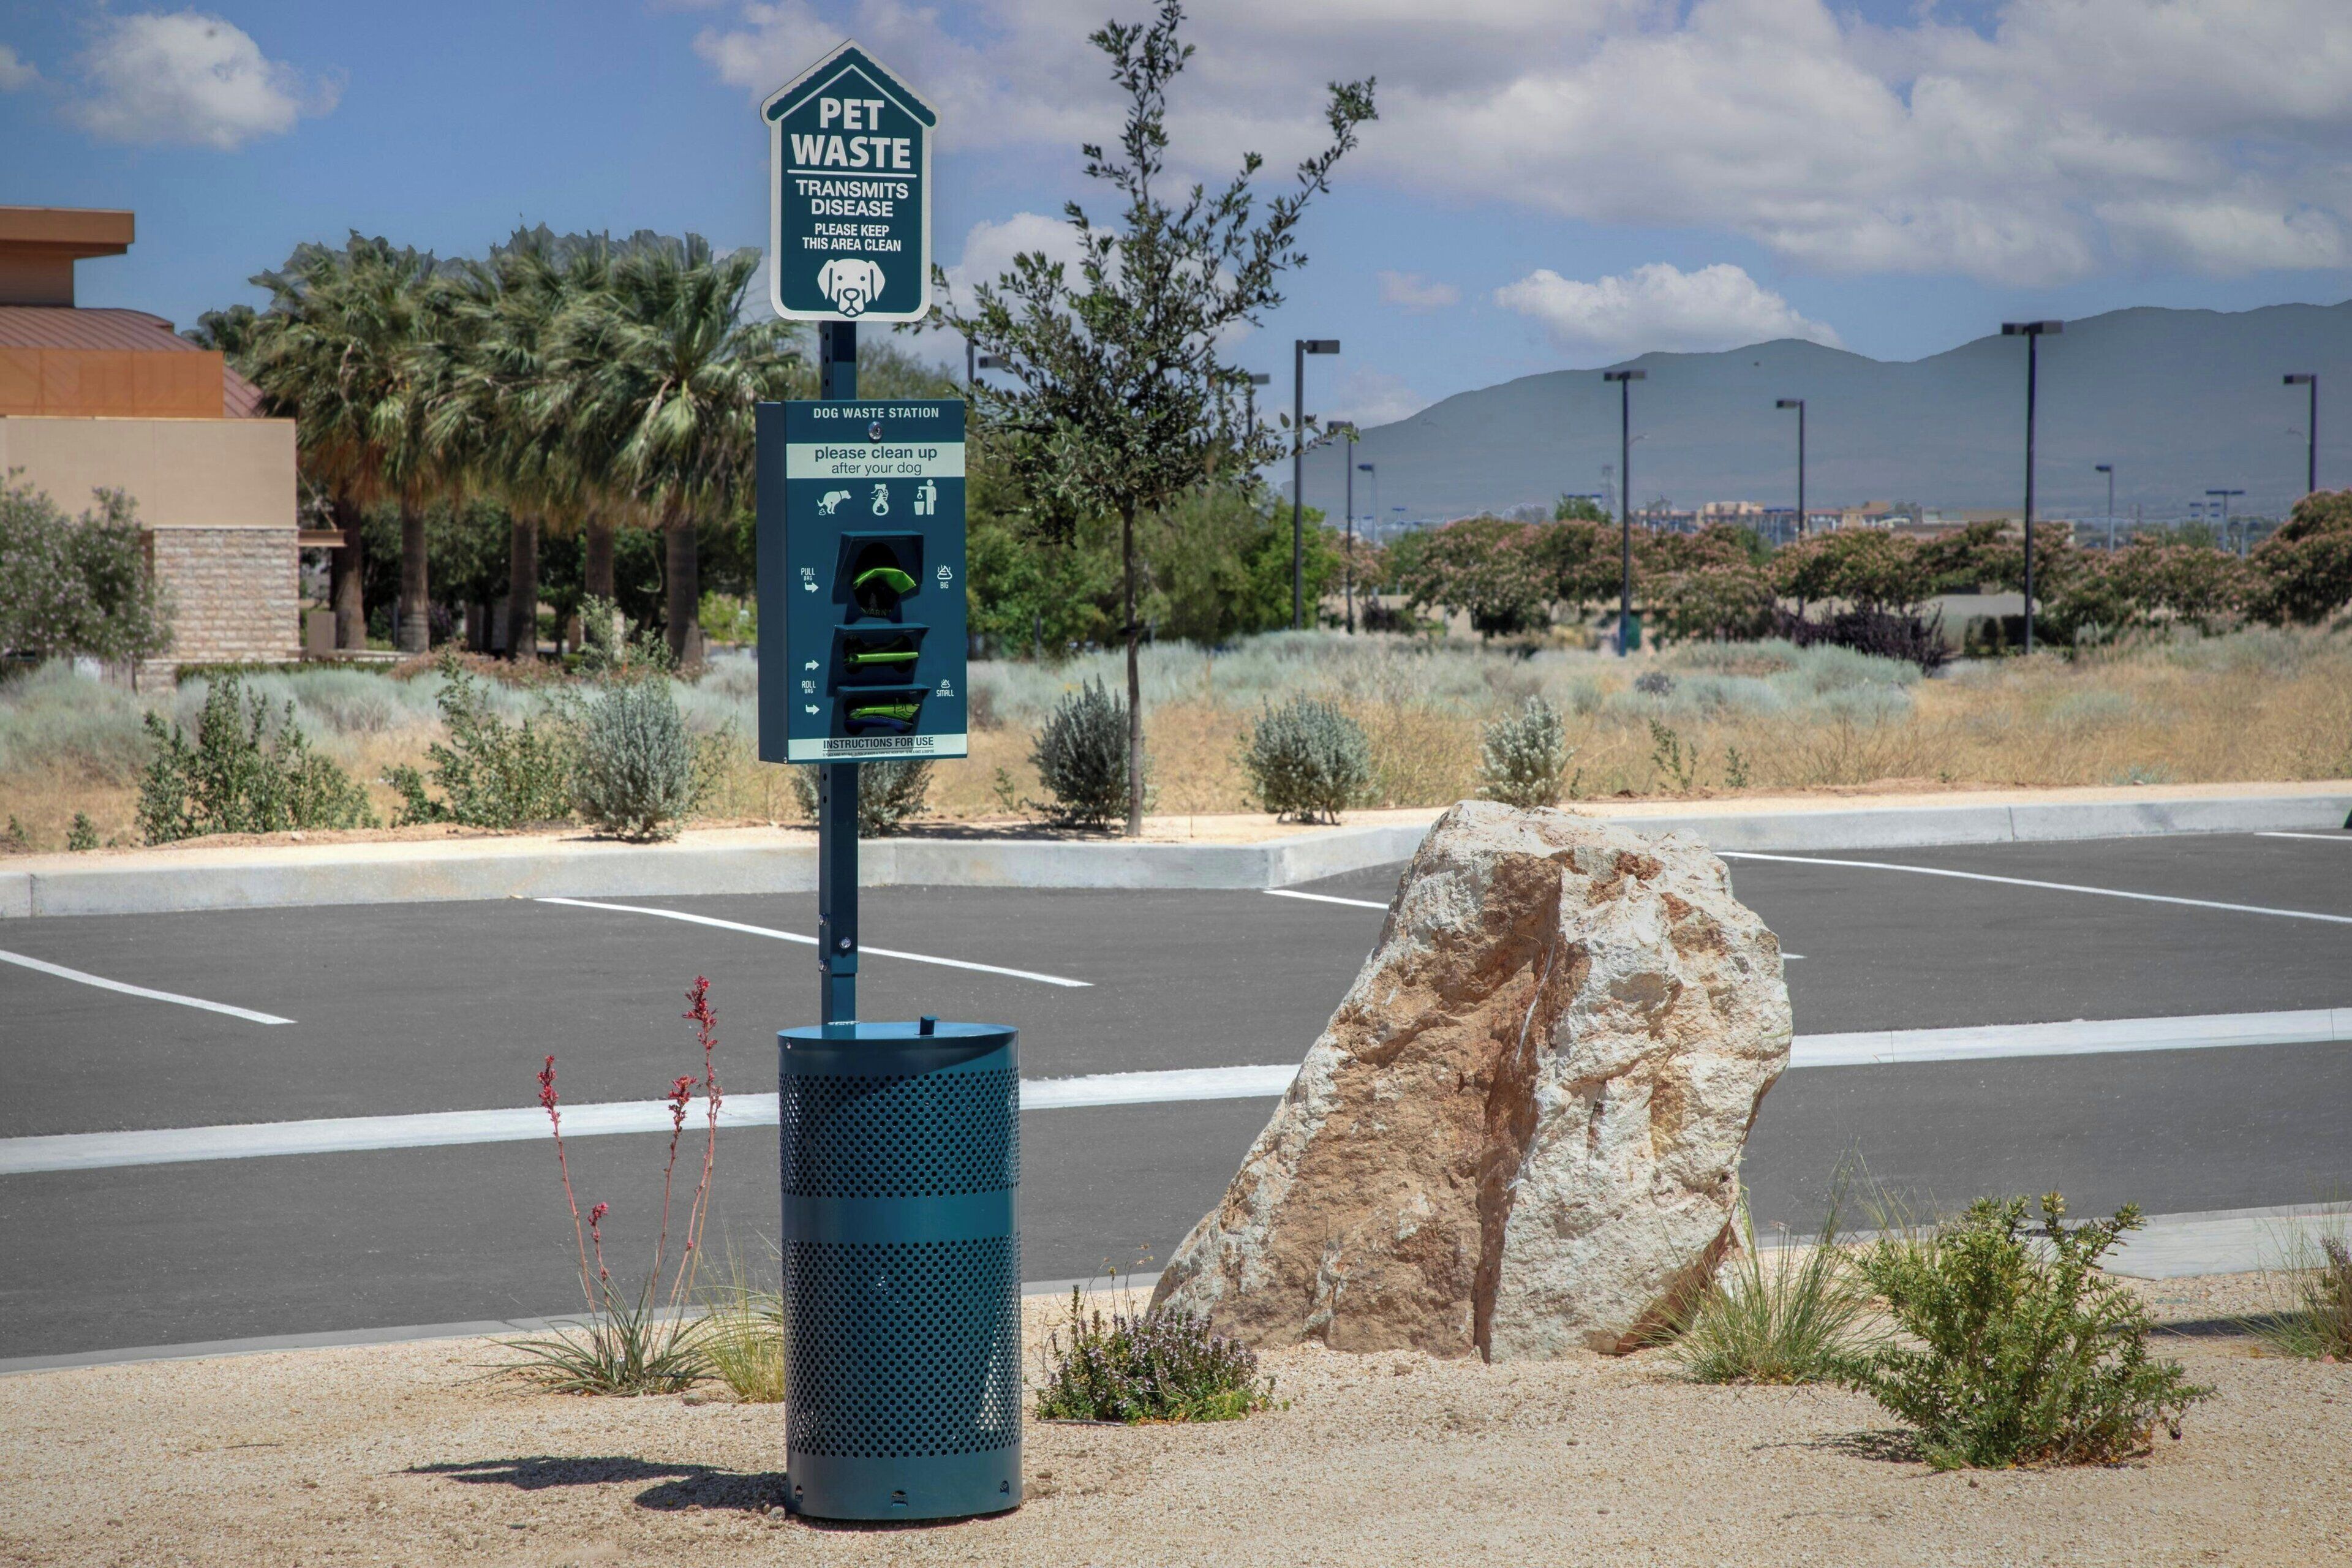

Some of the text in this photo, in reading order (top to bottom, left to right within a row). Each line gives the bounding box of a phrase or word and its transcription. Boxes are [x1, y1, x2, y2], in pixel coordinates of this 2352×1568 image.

[820, 97, 884, 130] PET
[791, 134, 911, 168] WASTE
[796, 179, 908, 199] TRANSMITS
[811, 199, 894, 217] DISEASE
[815, 224, 889, 237] PLEASE KEEP
[802, 237, 901, 252] THIS AREA CLEAN
[813, 407, 939, 418] DOG WASTE STATION
[815, 446, 938, 462] please clean up
[831, 461, 922, 476] after your dog
[823, 737, 933, 748] INSTRUCTIONS FOR USE
